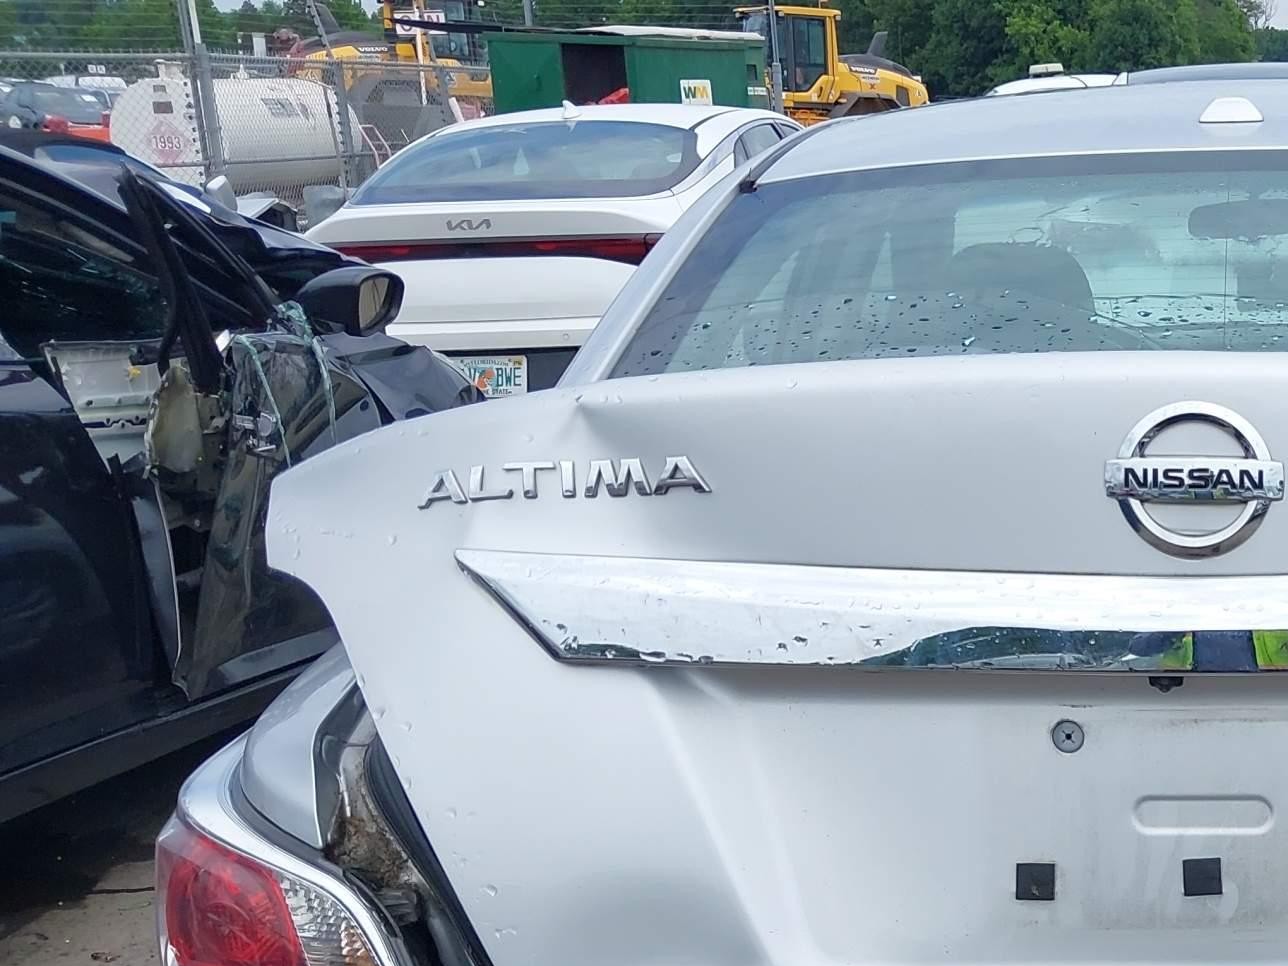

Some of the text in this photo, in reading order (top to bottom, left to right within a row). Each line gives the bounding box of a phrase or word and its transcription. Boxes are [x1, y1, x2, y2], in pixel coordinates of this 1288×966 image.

[683, 86, 709, 99] WM
[152, 135, 182, 149] 1993
[446, 218, 492, 231] KIA
[496, 367, 522, 387] BWE
[417, 455, 713, 510] ALTIMA
[1123, 467, 1264, 490] NISSAN
